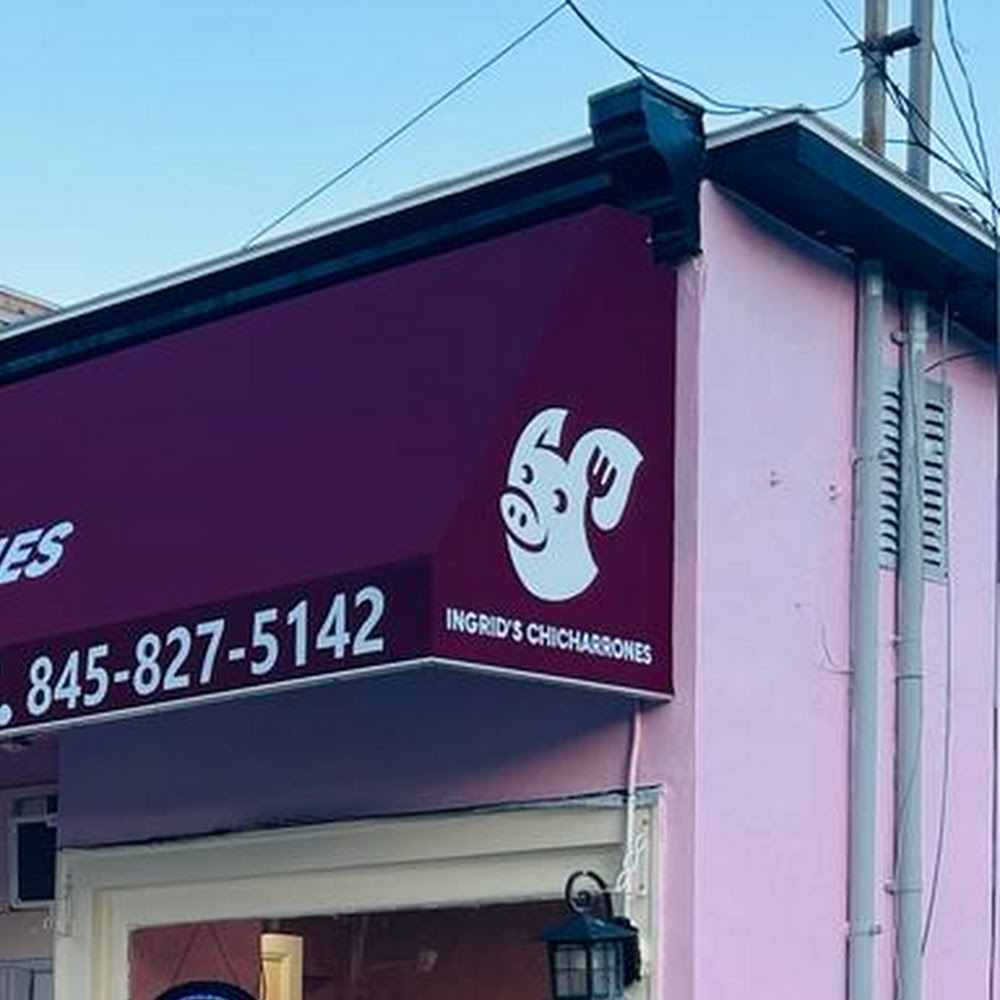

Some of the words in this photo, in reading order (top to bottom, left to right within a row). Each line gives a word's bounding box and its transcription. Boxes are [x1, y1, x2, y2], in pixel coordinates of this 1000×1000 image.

[27, 586, 386, 716] 845-827-5142
[446, 608, 523, 641] INGRID'S
[526, 623, 653, 665] CHICHARRONES
